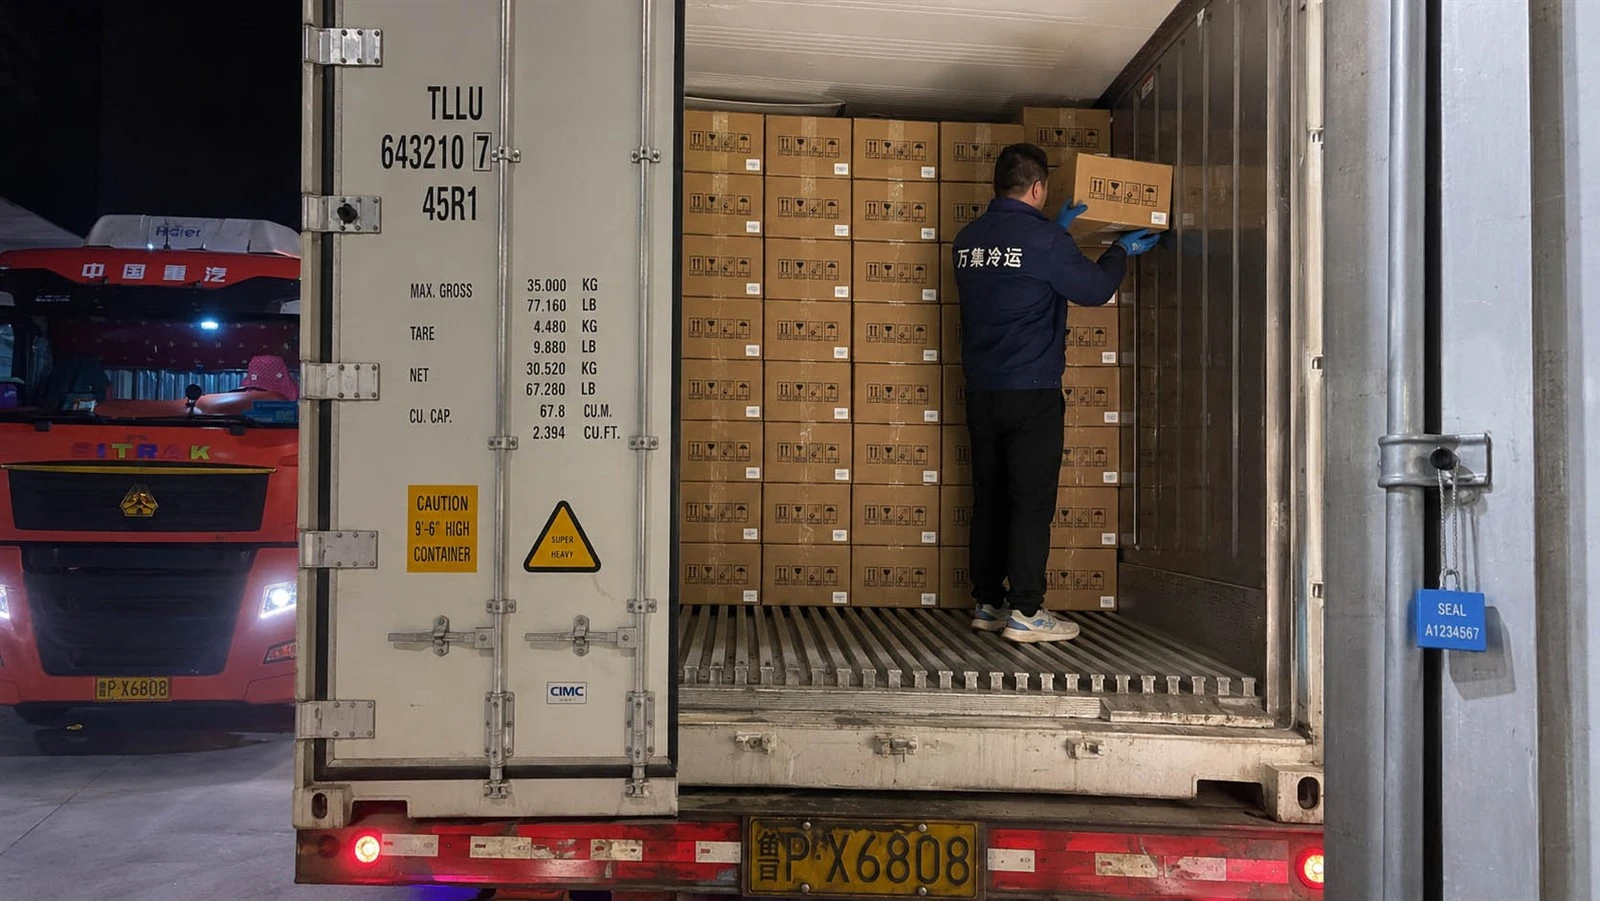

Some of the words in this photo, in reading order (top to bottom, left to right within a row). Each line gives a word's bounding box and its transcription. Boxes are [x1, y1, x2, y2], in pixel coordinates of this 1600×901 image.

[427, 86, 483, 121] TLLU
[381, 135, 464, 169] 643210
[476, 135, 489, 169] 7
[422, 186, 477, 221] 45R1
[156, 226, 201, 238] Haier
[957, 246, 1023, 269] 万集冷运
[81, 262, 228, 283] 中国重汽
[410, 283, 436, 298] MAX.
[439, 283, 473, 298] GROSS
[527, 278, 567, 292] 35.000
[582, 278, 598, 291] KG
[527, 299, 567, 312] 77.160
[582, 298, 597, 311] LB
[410, 326, 435, 341] TARE
[533, 321, 566, 333] 4.480
[582, 320, 598, 332] KG
[533, 341, 566, 354] 9.880
[582, 340, 596, 353] LB
[409, 368, 429, 382] NET
[526, 362, 566, 375] 30.520
[581, 361, 597, 375] KG
[526, 382, 566, 396] 67.280
[581, 382, 596, 395] LB
[409, 409, 427, 423] CU.
[430, 409, 452, 423] CAP.
[540, 405, 565, 418] 67.8
[583, 404, 612, 418] CU.M.
[533, 426, 565, 439] 2.394
[584, 425, 621, 439] CU.FT.
[71, 441, 210, 461] SITRAK
[416, 495, 468, 511] CAUTION
[445, 520, 470, 537] HIGH
[551, 535, 574, 544] SUPER
[413, 546, 471, 562] CONTAINER
[551, 550, 574, 559] HEAVY
[1438, 603, 1467, 617] SEAL
[1425, 624, 1480, 640] A1234567
[550, 686, 584, 697] CIMC
